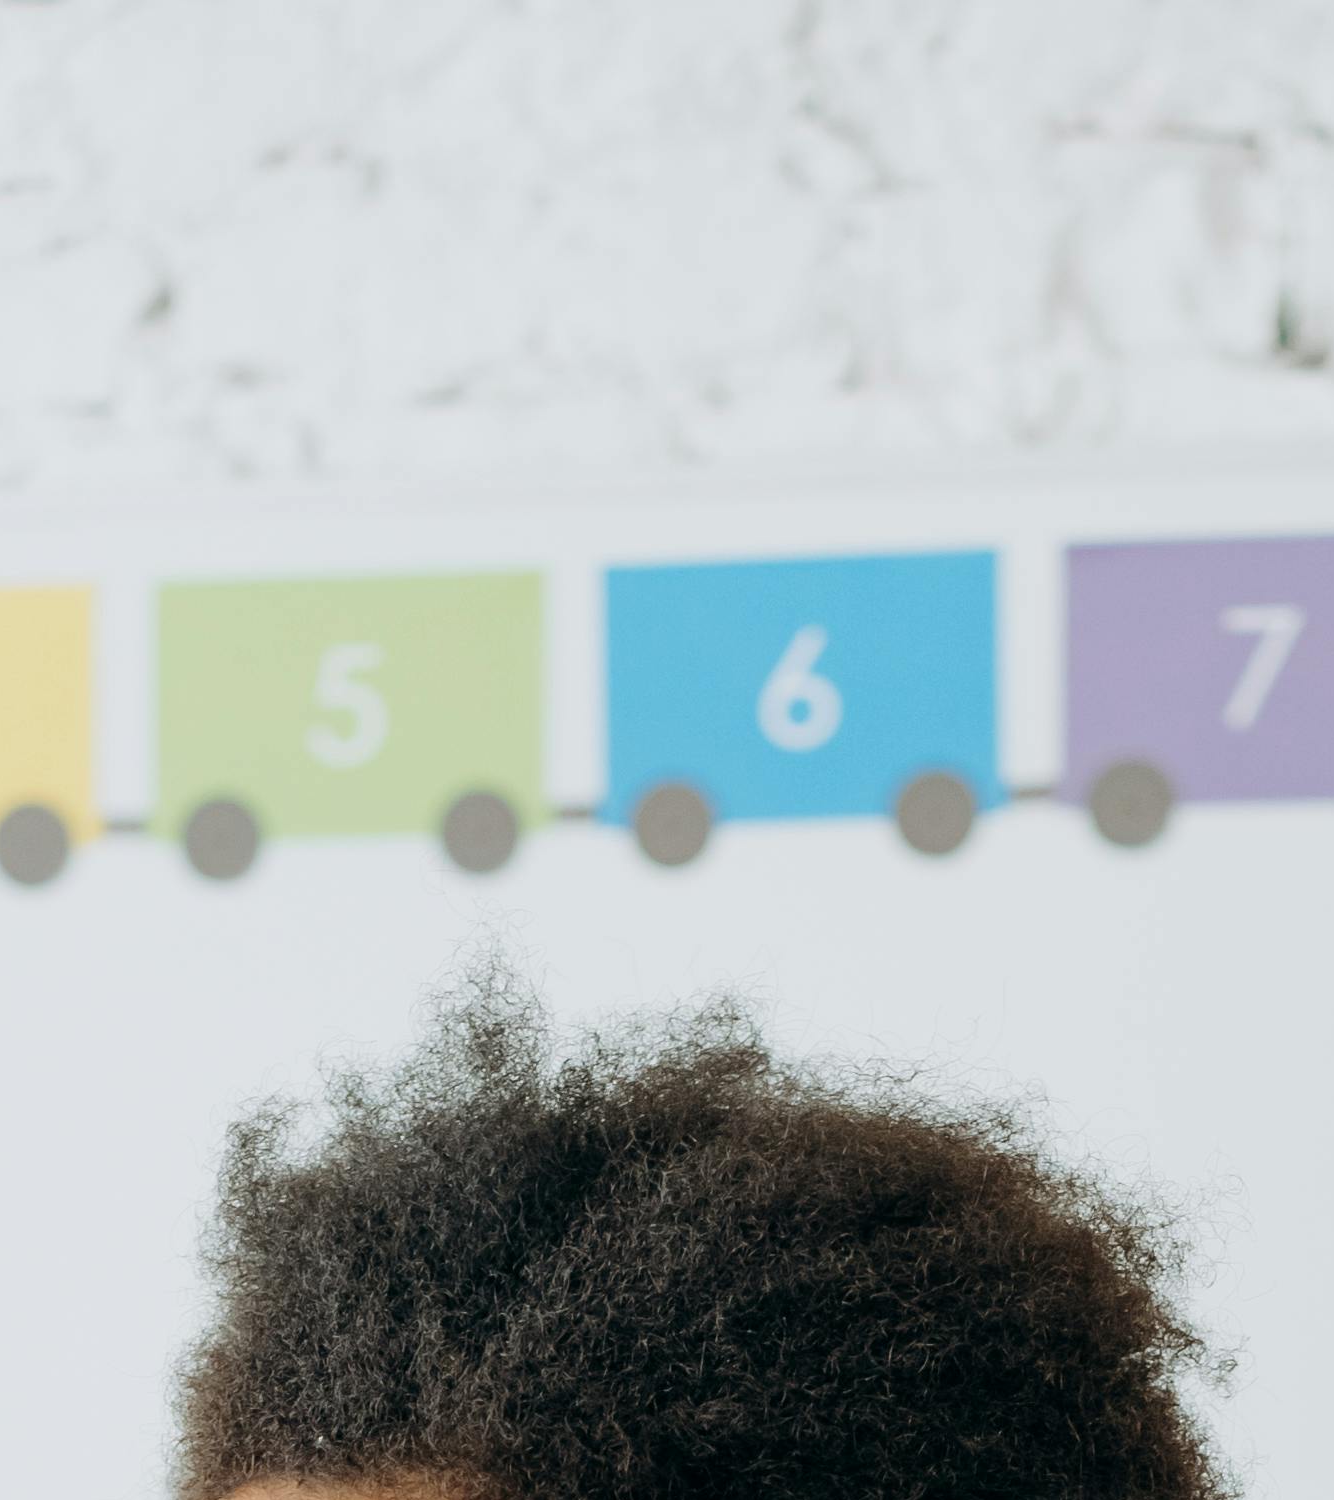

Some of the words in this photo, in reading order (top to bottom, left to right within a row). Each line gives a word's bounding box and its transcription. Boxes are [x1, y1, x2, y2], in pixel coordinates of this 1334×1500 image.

[305, 642, 389, 769] 5
[758, 627, 842, 751] 6
[1223, 605, 1304, 728] 7
